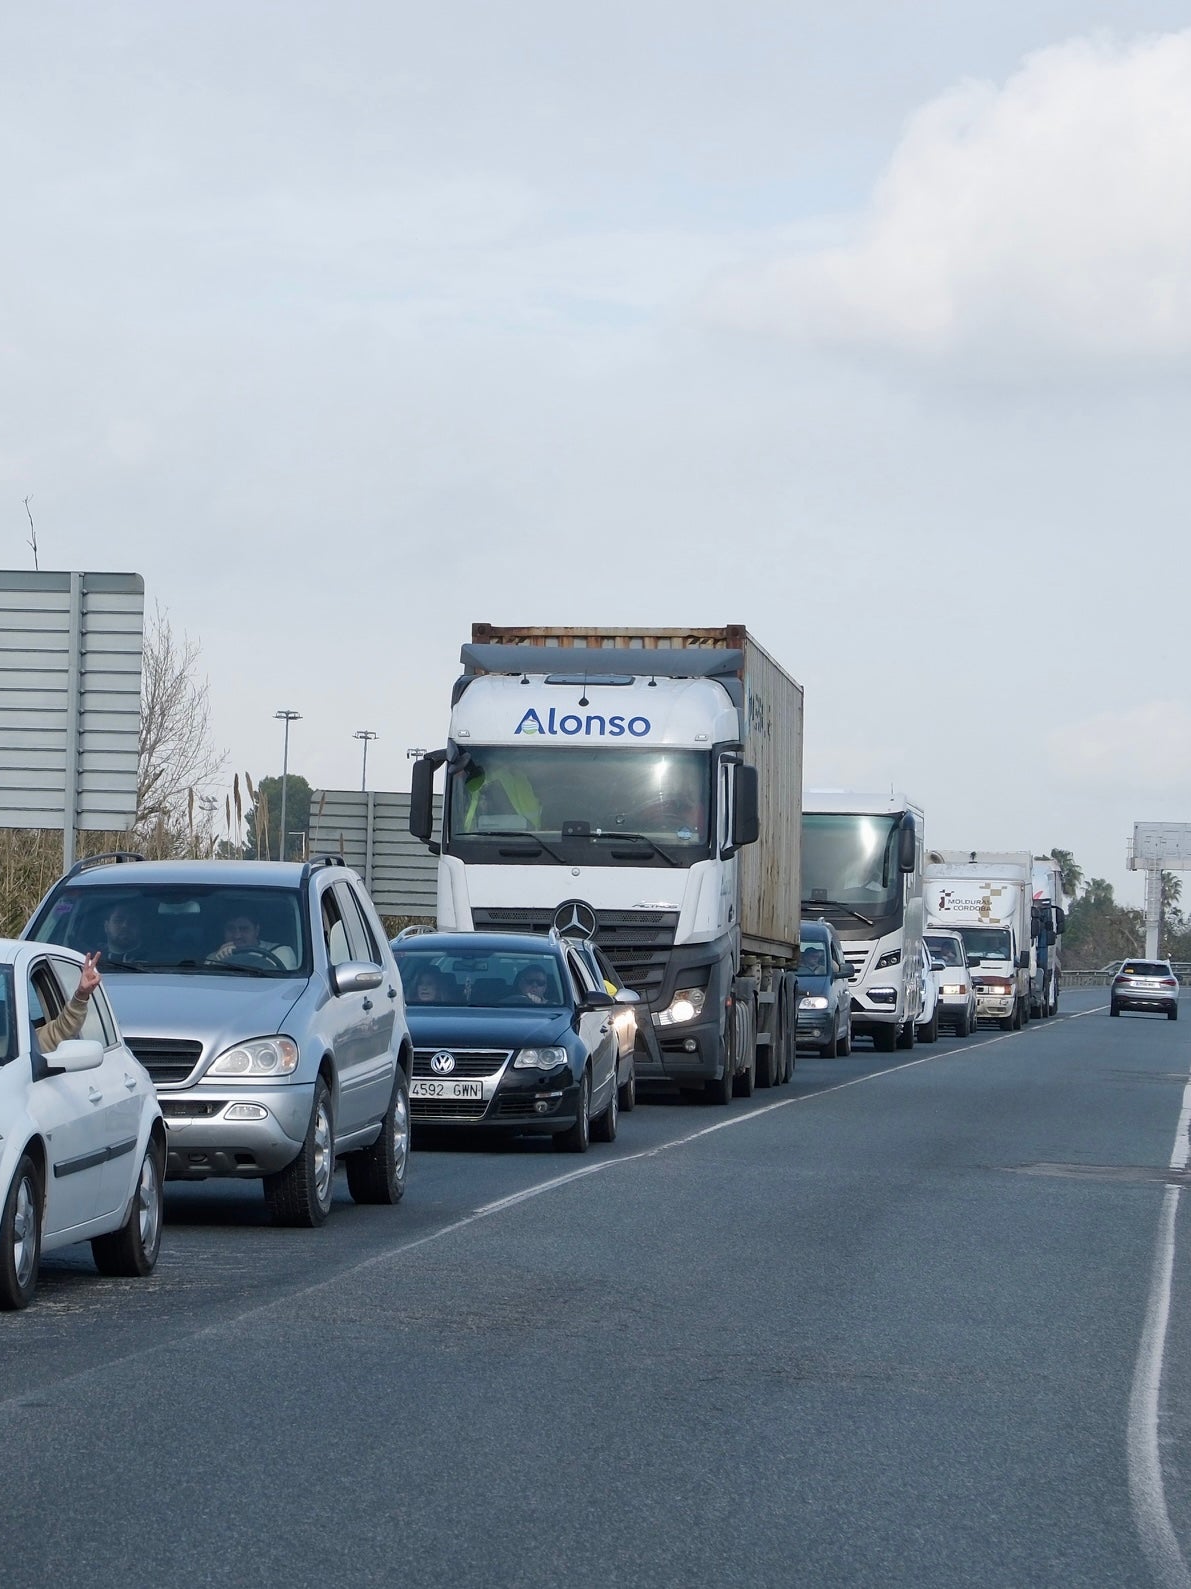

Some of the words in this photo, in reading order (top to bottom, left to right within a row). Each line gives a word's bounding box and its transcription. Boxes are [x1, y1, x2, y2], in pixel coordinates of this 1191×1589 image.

[514, 708, 651, 737] Alonso
[412, 1084, 444, 1096] 4592
[454, 1084, 478, 1097] GWN
